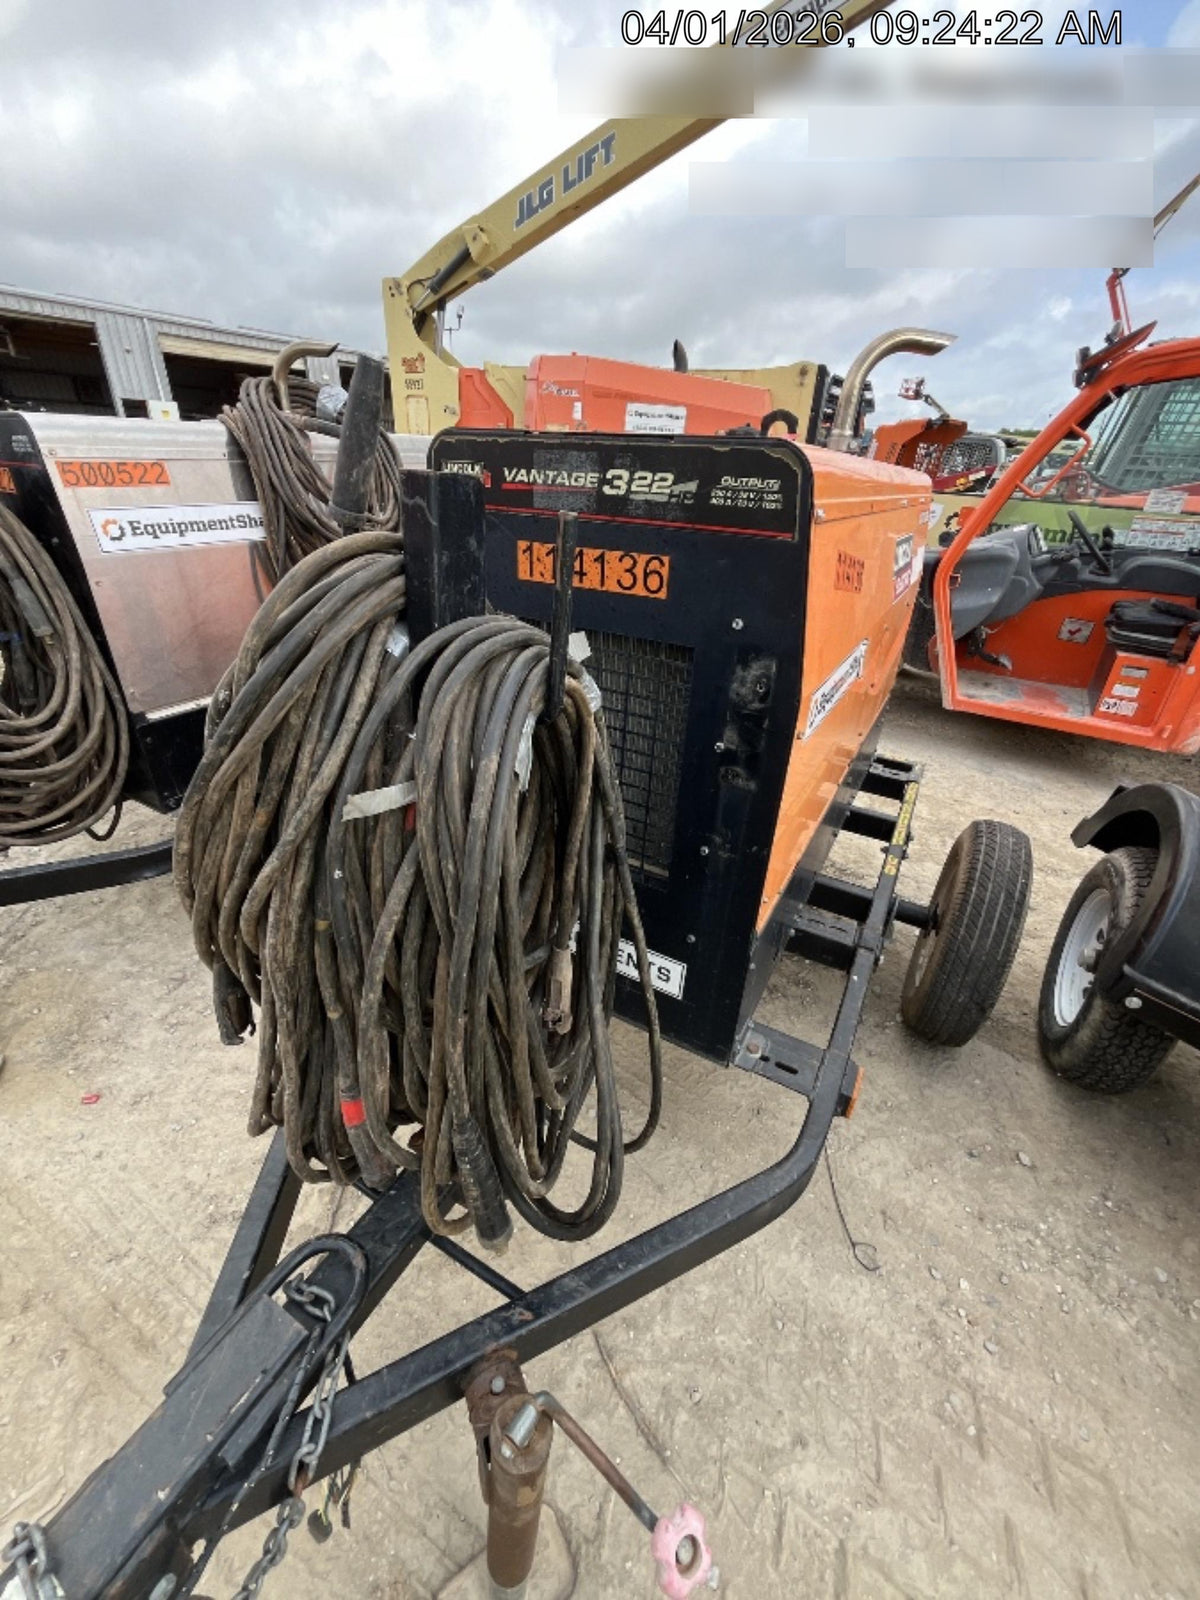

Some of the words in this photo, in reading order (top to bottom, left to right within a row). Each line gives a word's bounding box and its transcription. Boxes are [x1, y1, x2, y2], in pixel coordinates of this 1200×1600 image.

[514, 174, 555, 230] JLG
[562, 130, 616, 195] LIFT
[61, 462, 169, 486] 500522
[503, 467, 599, 487] VANTAGE
[602, 469, 675, 495] 322
[127, 514, 264, 539] EquipmentSha
[522, 542, 666, 594] 114136
